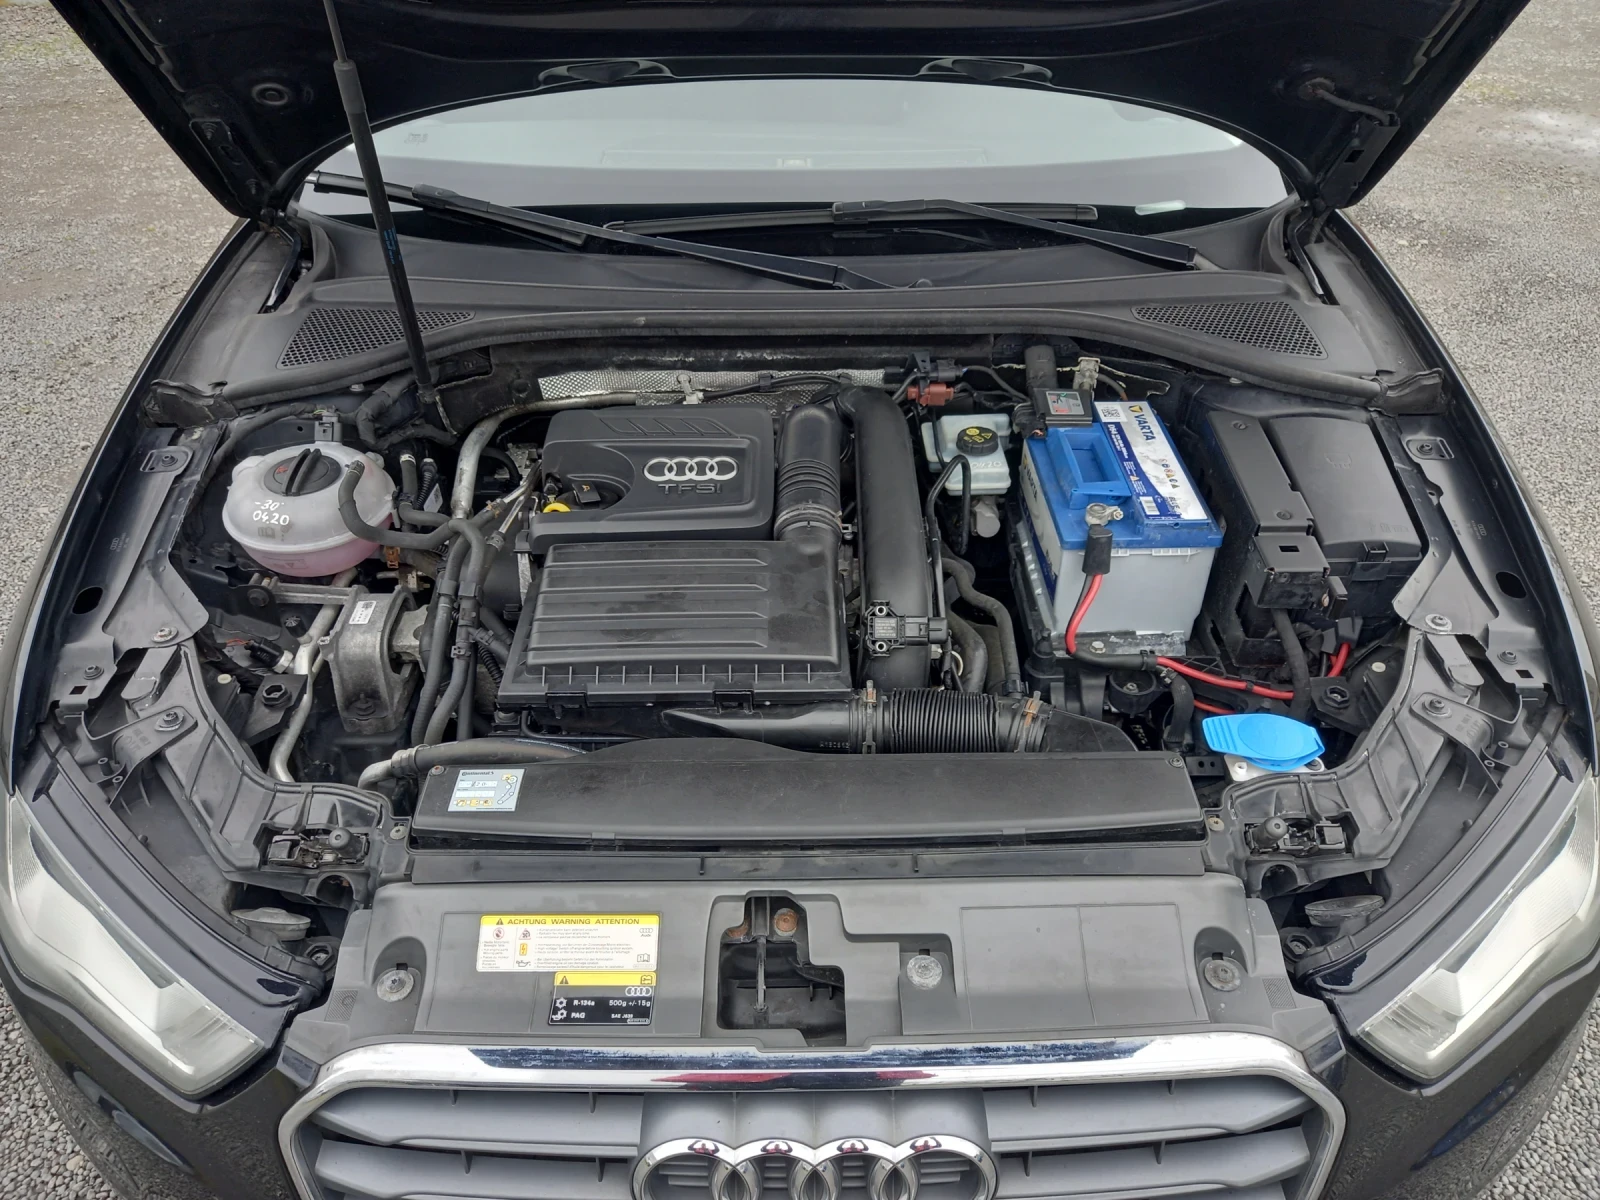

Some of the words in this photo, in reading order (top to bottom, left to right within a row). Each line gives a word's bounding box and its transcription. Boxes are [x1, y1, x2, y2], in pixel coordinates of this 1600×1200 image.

[1134, 413, 1157, 441] VARTA
[657, 483, 722, 495] TFSI
[253, 510, 290, 525] 04.20
[609, 999, 627, 1007] 500g
[638, 999, 651, 1007] 15g
